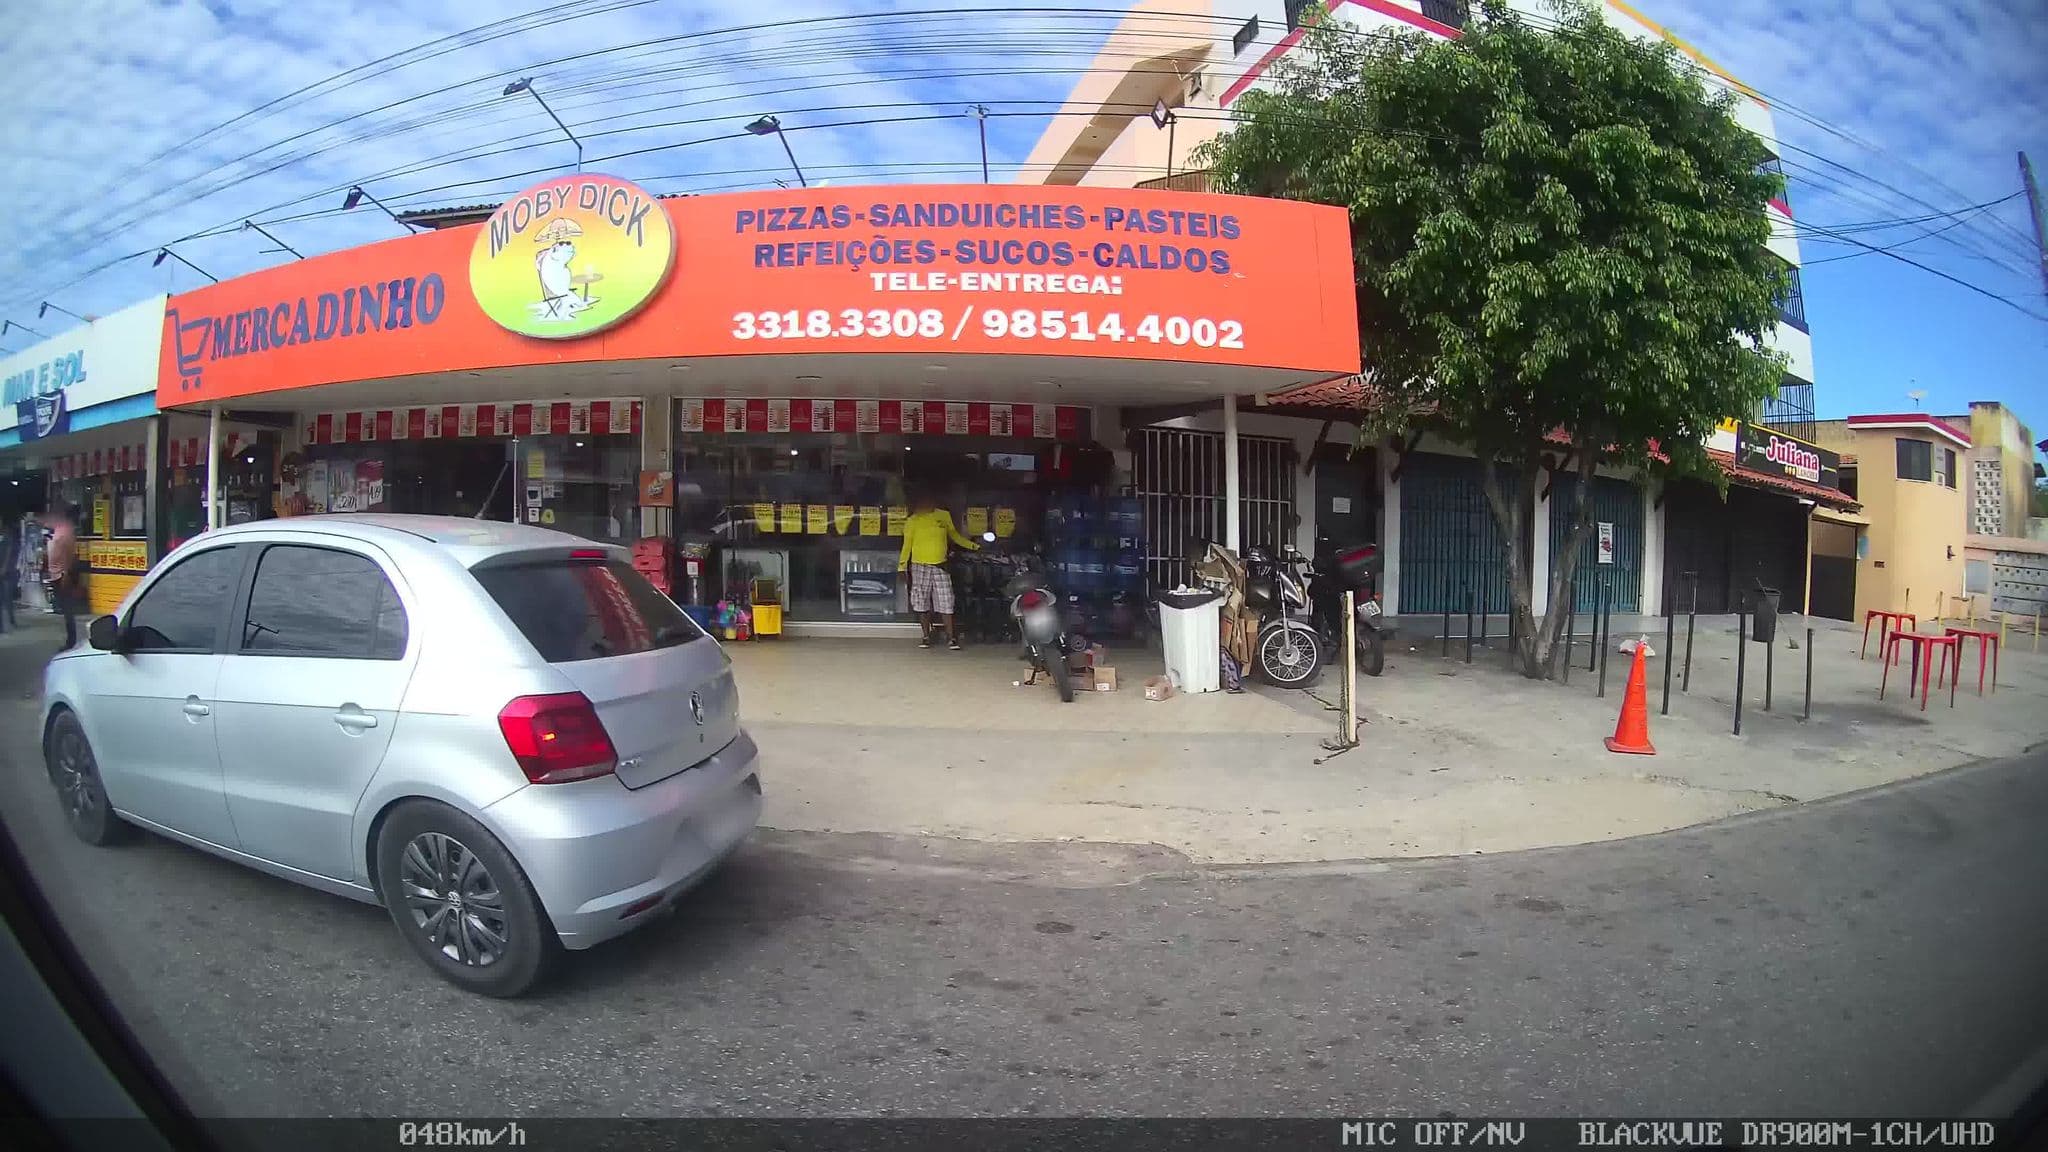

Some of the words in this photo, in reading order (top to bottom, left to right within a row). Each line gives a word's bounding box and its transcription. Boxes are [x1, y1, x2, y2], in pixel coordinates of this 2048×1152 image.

[490, 185, 571, 258] MOBY
[579, 184, 650, 247] DICK
[870, 272, 1122, 295] TELE-ENTREGA:
[210, 272, 445, 361] MERCADINHO
[732, 308, 945, 340] 3318.3308
[982, 309, 1244, 349] 98514.4002
[52, 349, 87, 391] SOL
[1766, 436, 1819, 471] Juliana
